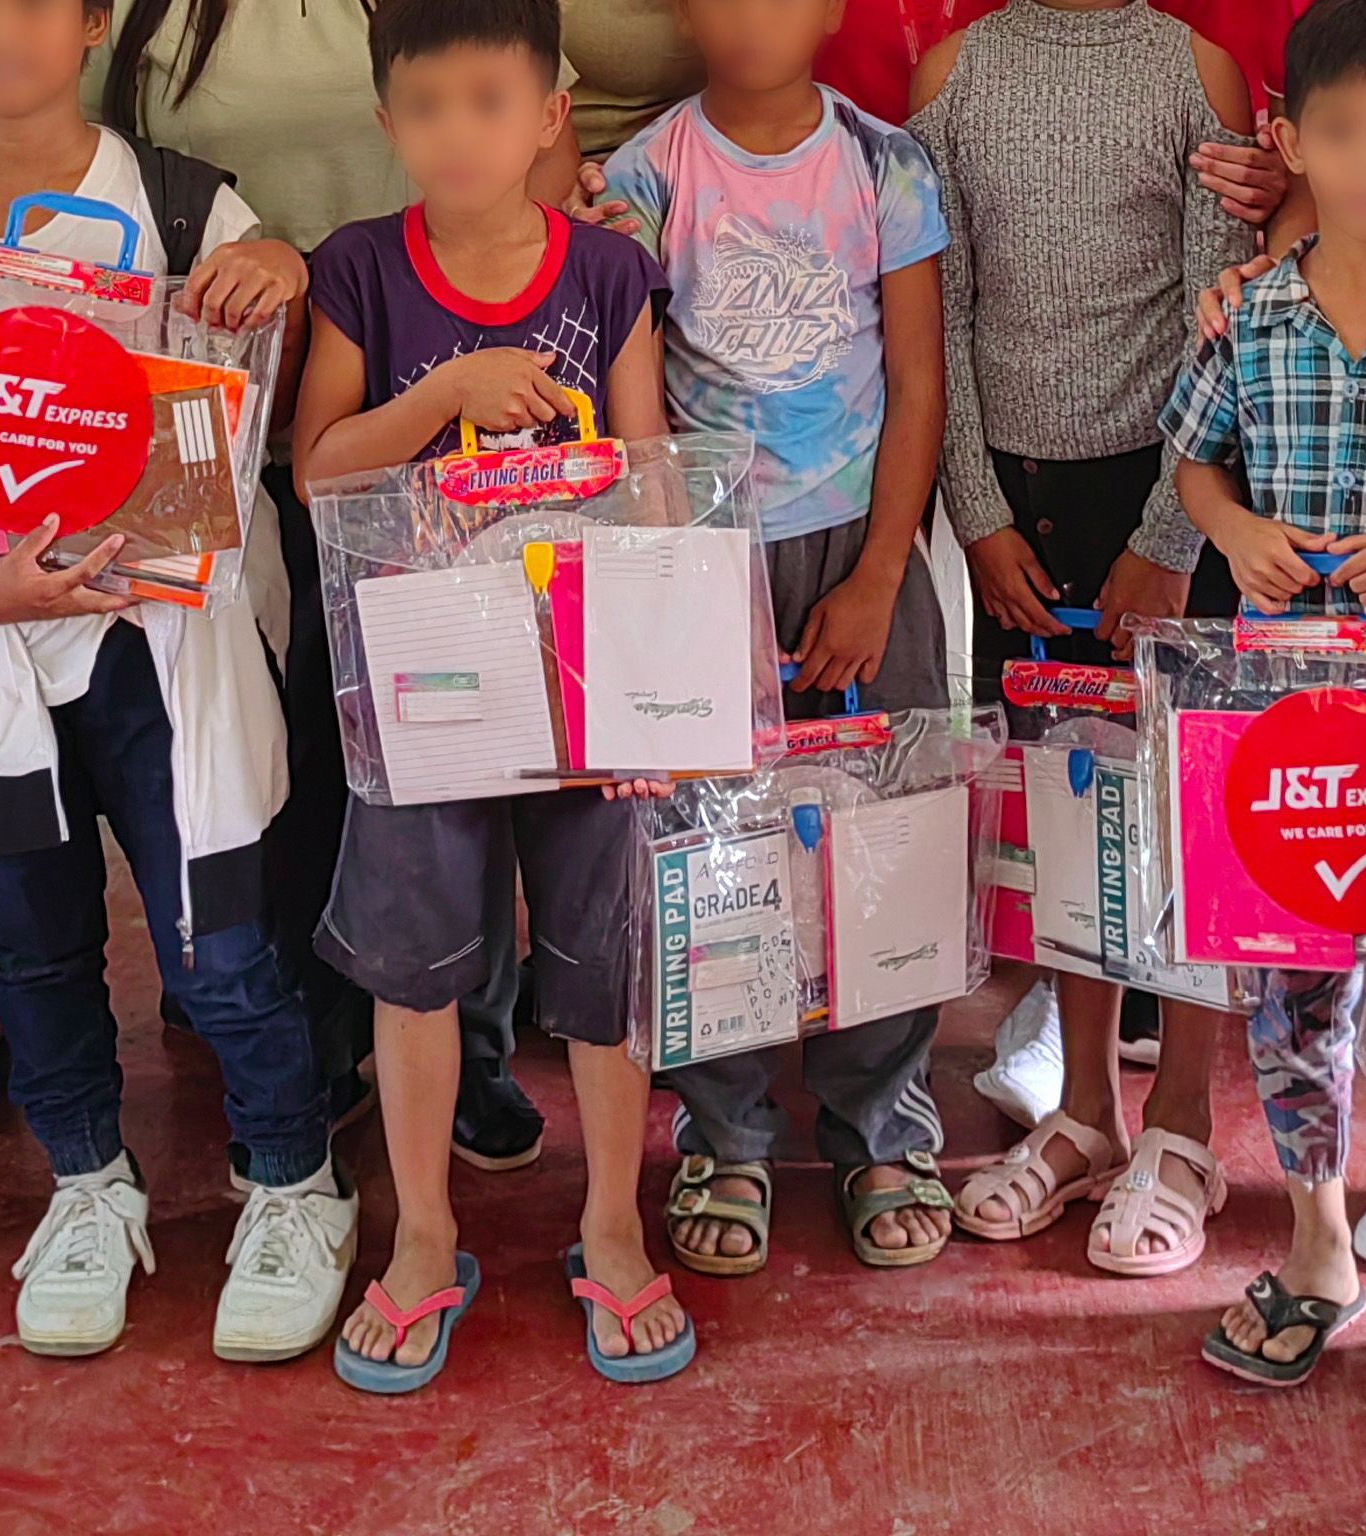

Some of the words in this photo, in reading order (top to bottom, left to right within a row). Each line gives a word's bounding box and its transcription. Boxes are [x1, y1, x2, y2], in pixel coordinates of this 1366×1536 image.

[691, 271, 845, 311] SANTA
[708, 322, 833, 359] CRUZ
[45, 405, 128, 430] EXPRESS
[0, 432, 35, 447] CARE
[37, 437, 65, 451] FOR
[69, 442, 97, 455] YOU
[469, 468, 518, 491] FLYING
[523, 462, 565, 484] EAGLE
[1251, 764, 1359, 812] J&T
[1102, 788, 1122, 841] PAD
[1281, 827, 1304, 840] WE
[1307, 826, 1343, 838] CARE
[663, 867, 685, 924] PAD
[694, 884, 761, 919] GRADE
[665, 925, 688, 1055] WRITING
